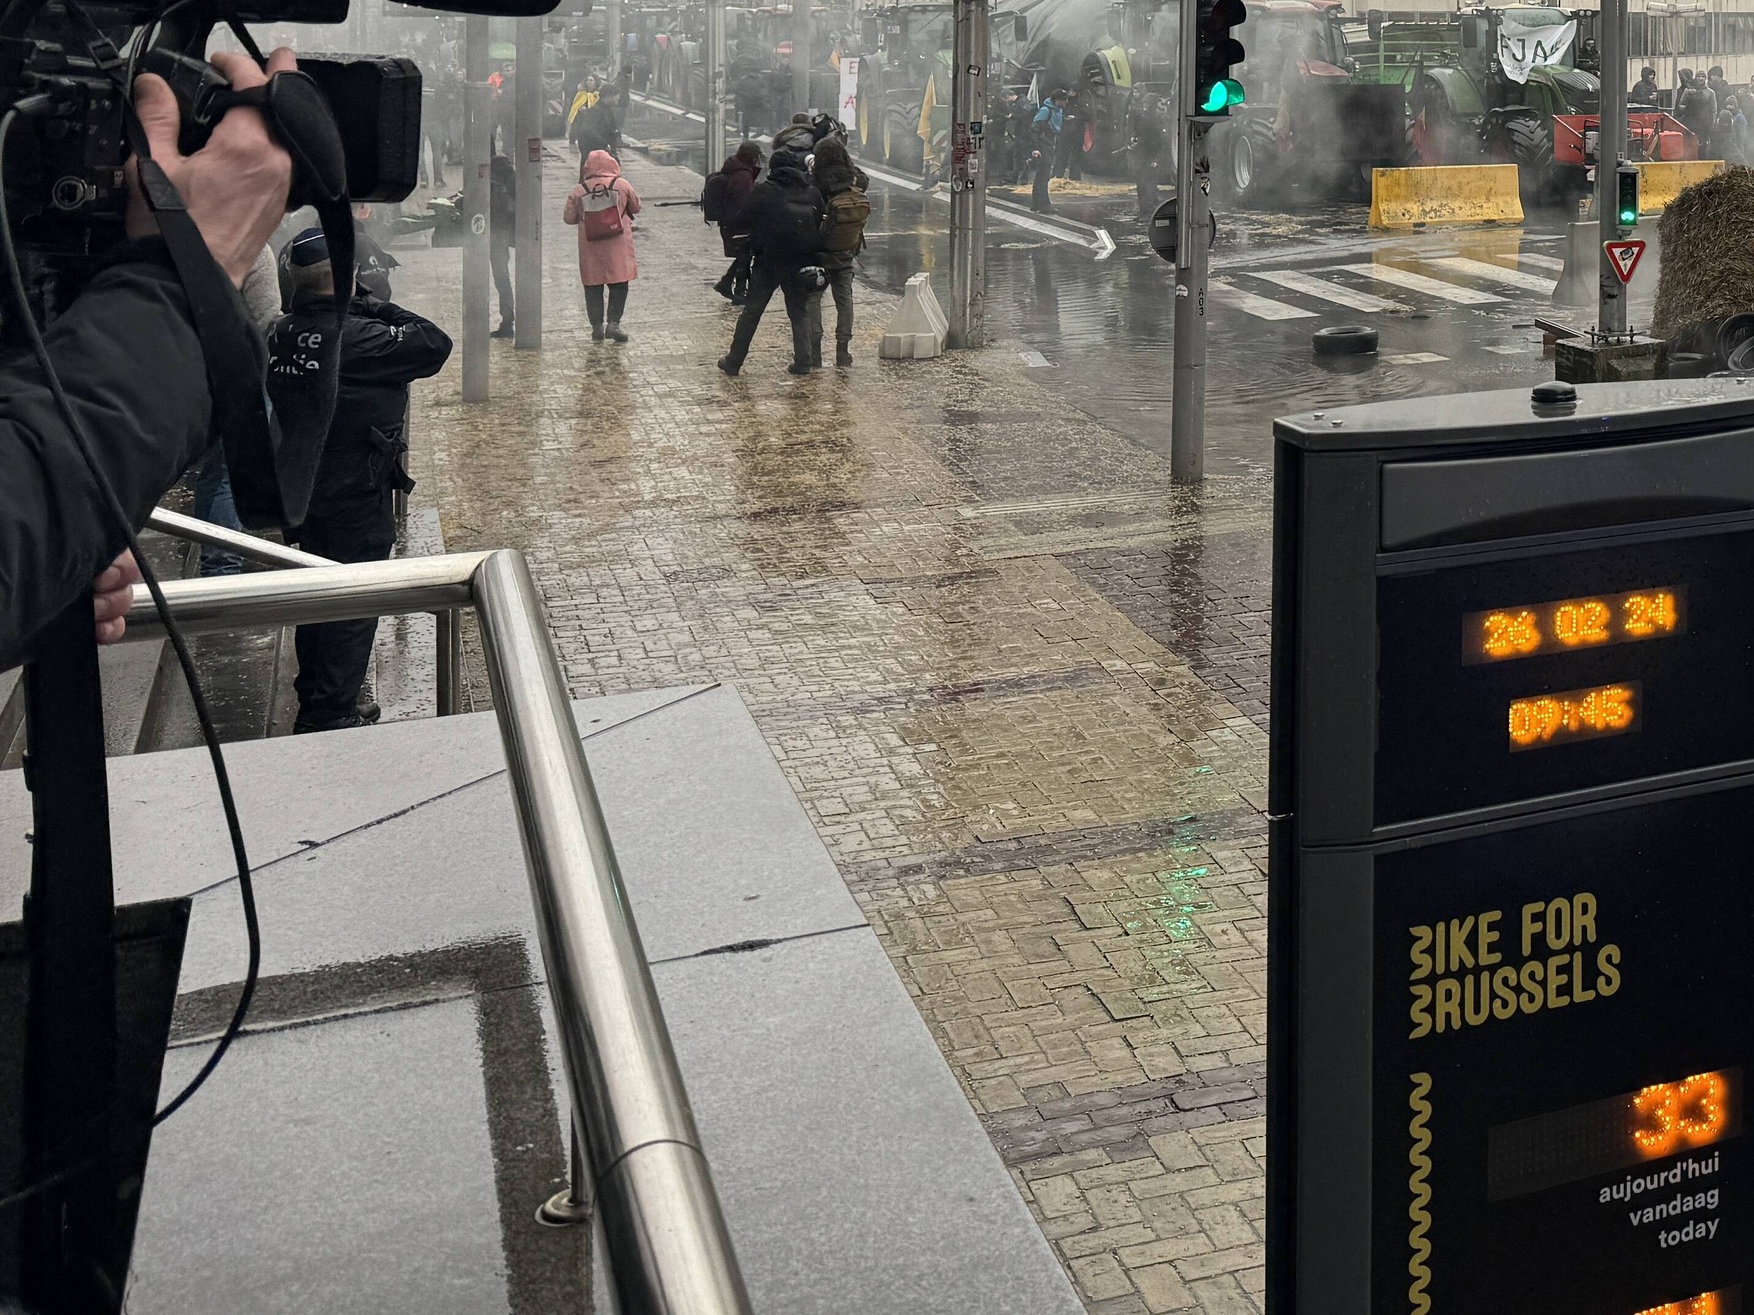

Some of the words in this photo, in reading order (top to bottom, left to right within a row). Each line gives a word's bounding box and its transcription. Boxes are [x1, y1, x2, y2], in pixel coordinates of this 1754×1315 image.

[1484, 611, 1541, 656] 26
[1554, 599, 1610, 646] 02
[1621, 592, 1677, 635] 24
[1508, 686, 1633, 745] 09:45
[1409, 909, 1503, 981] BIKE
[1521, 892, 1597, 958] FOR
[1408, 943, 1622, 1040] BRUSSELS
[1632, 1071, 1727, 1159] 33
[1599, 1151, 1720, 1204] aujourd'hui
[1628, 1187, 1720, 1227] vandaag
[1658, 1217, 1721, 1249] today
